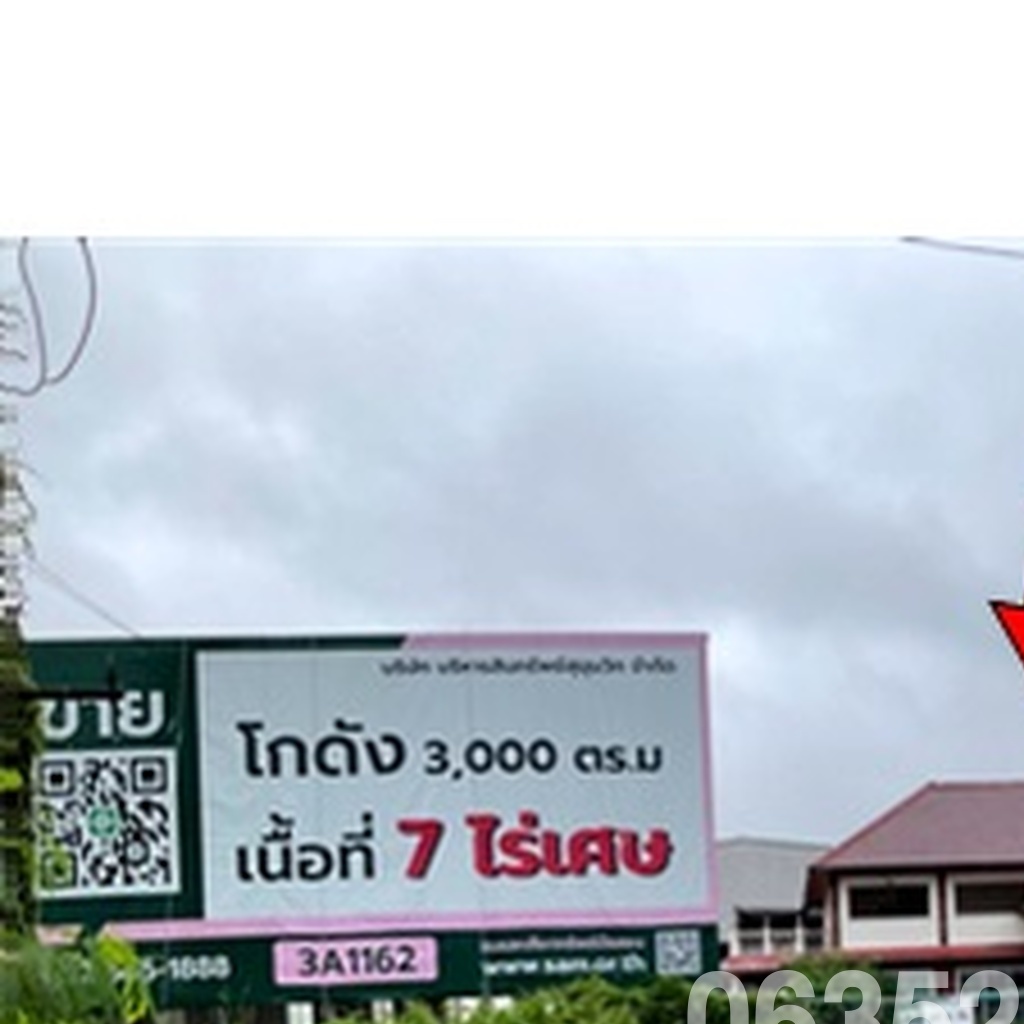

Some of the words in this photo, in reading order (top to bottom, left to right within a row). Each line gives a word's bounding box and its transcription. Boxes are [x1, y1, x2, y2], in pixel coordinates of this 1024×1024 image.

[37, 689, 165, 740] ขาย
[236, 719, 407, 778] โกดัง
[424, 738, 557, 780] 3,000
[573, 743, 663, 774] ตร.ม
[236, 811, 375, 883] เนื้อที่
[397, 818, 445, 880] 7
[465, 810, 675, 880] ไร่เศษ
[297, 944, 418, 977] 3A1162
